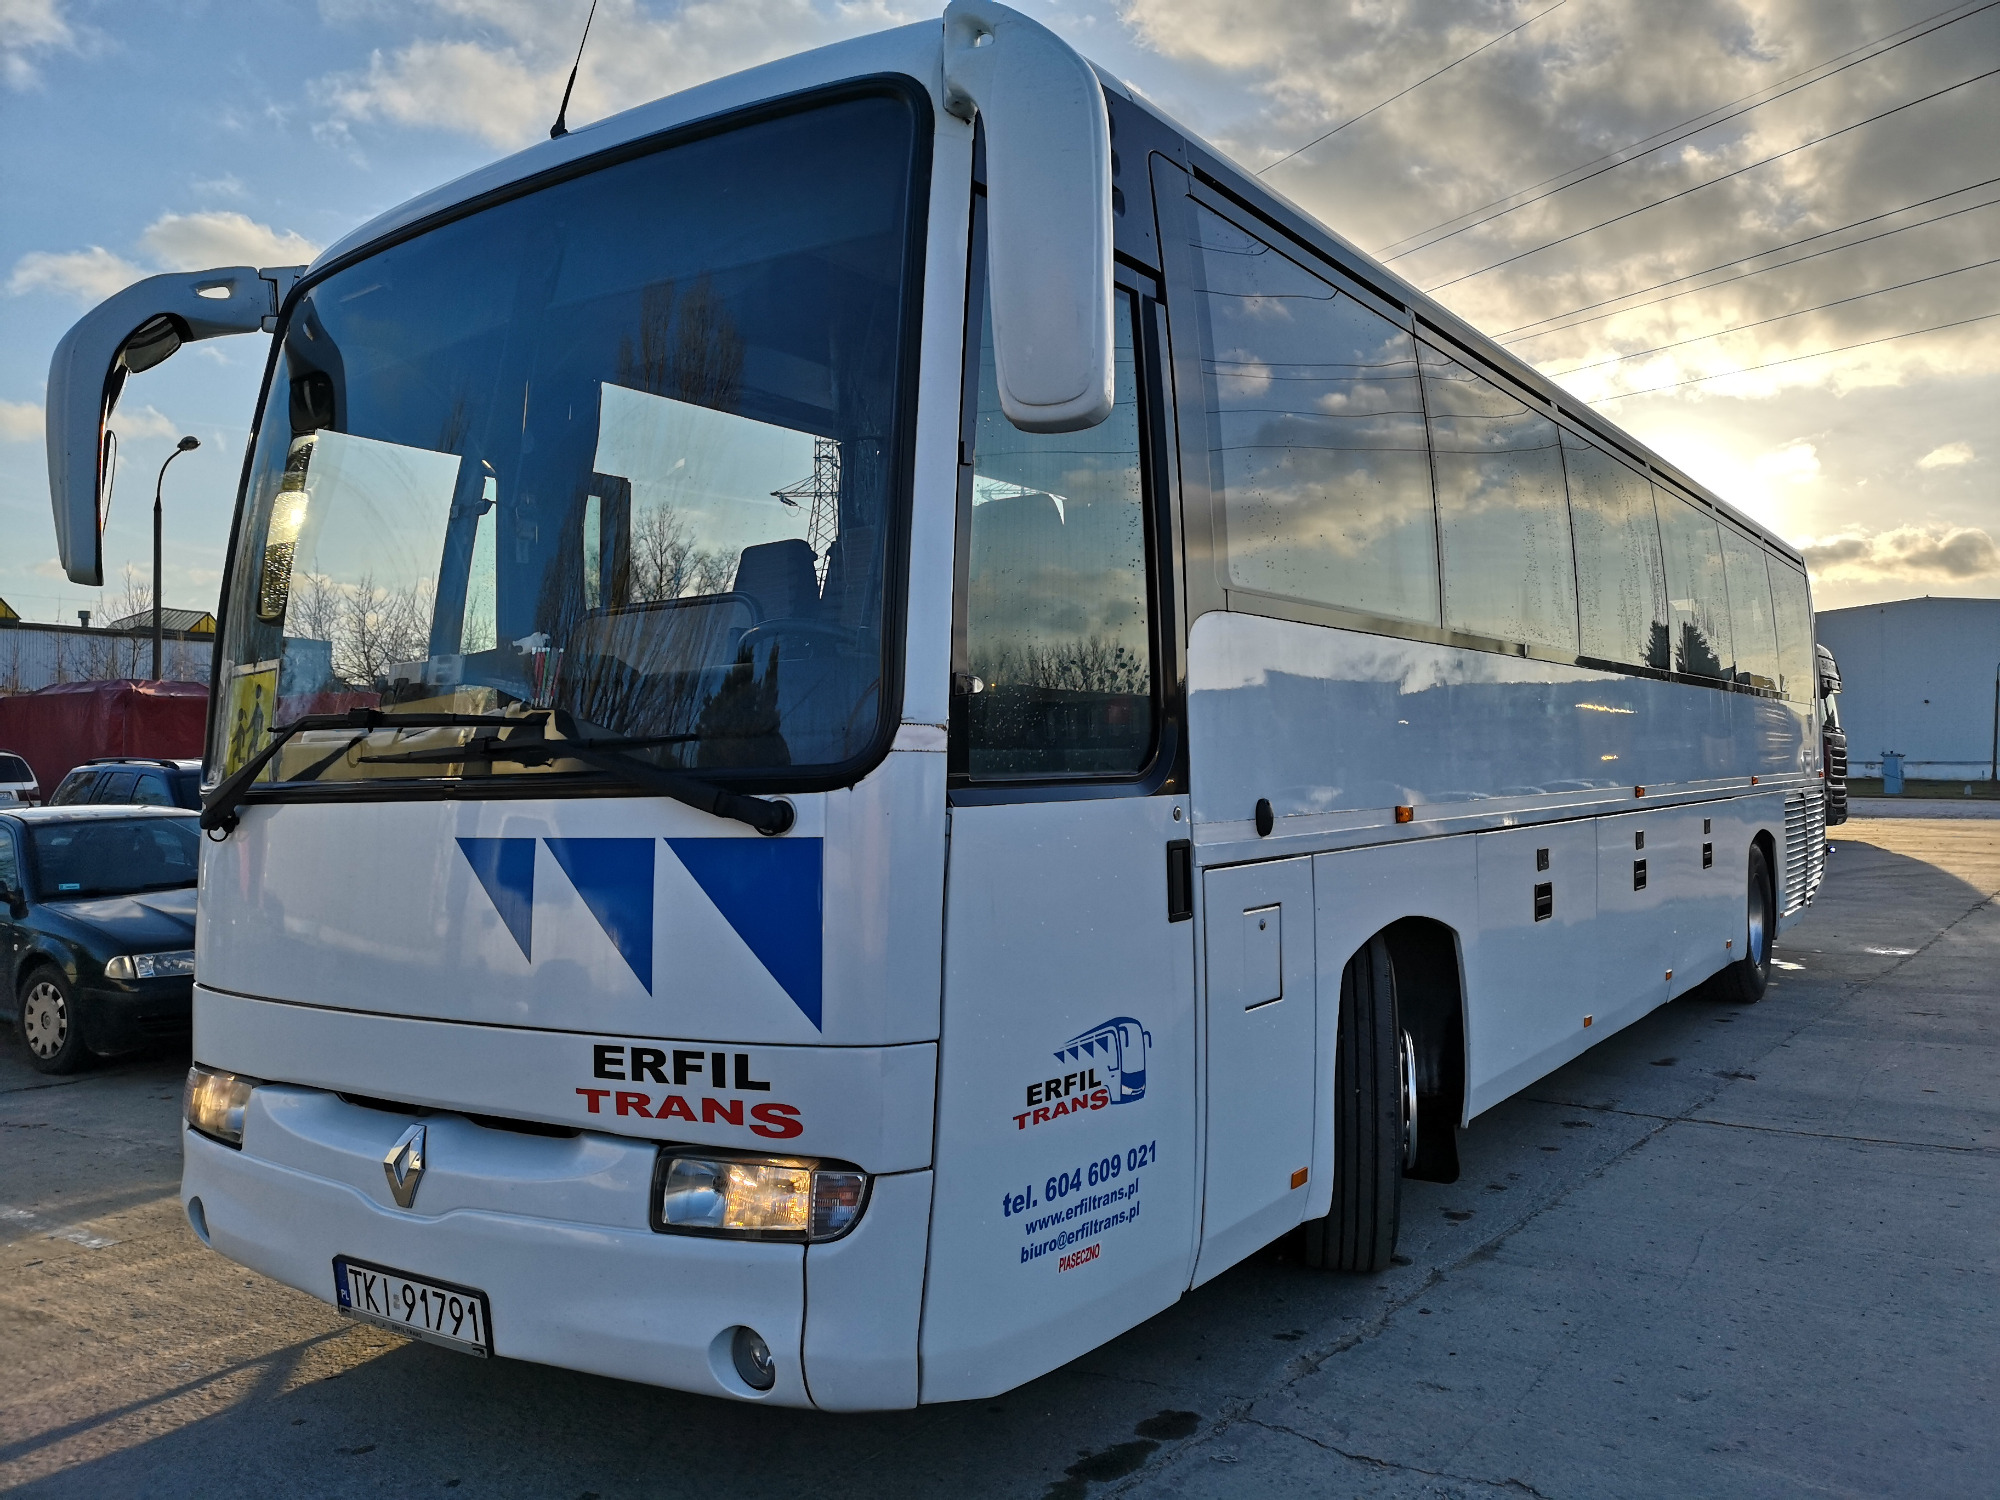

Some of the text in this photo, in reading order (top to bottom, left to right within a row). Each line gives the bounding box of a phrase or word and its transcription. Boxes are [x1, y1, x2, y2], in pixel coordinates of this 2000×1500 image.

[593, 1043, 771, 1092] ERFIL
[1026, 1068, 1102, 1107] ERFIL
[576, 1087, 804, 1140] TRANS
[1012, 1088, 1109, 1131] TRANS
[1002, 1140, 1156, 1218] tel. 604 609 021
[1025, 1177, 1139, 1236] www.erfiltrans.pl
[1020, 1201, 1140, 1264] biuro@erfiltrans.pl
[1058, 1243, 1100, 1273] PIASECZNO
[340, 1288, 350, 1301] PL
[348, 1268, 480, 1342] TKI 91791
